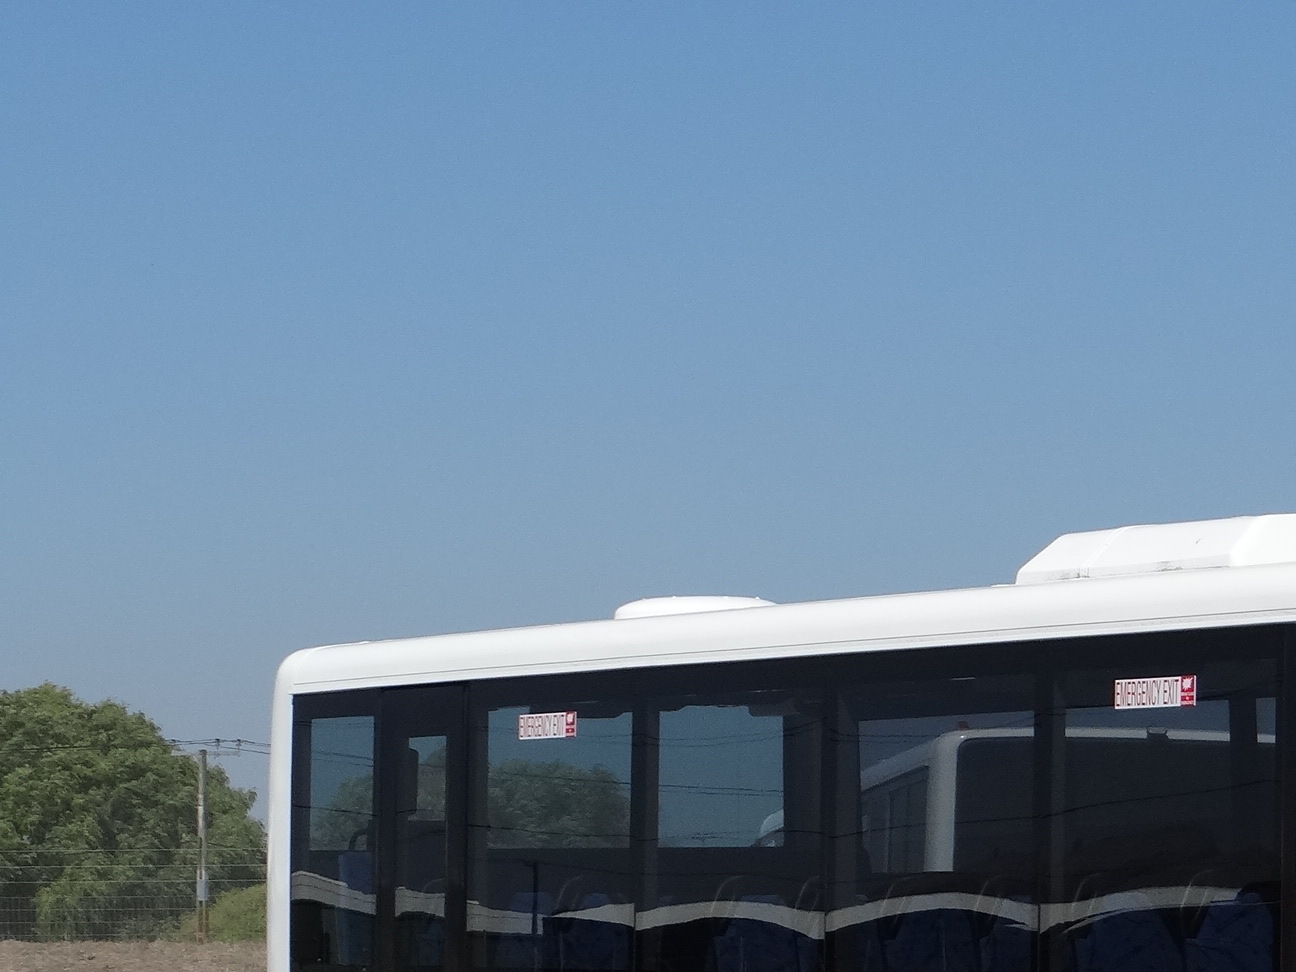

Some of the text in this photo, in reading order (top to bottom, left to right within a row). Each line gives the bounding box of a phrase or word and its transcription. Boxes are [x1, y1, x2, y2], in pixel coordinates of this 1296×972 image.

[1116, 680, 1161, 706] EMERGENCY
[1163, 679, 1179, 705] EXIT
[520, 715, 551, 738] EMERGENCY
[553, 714, 564, 736] EXIT
